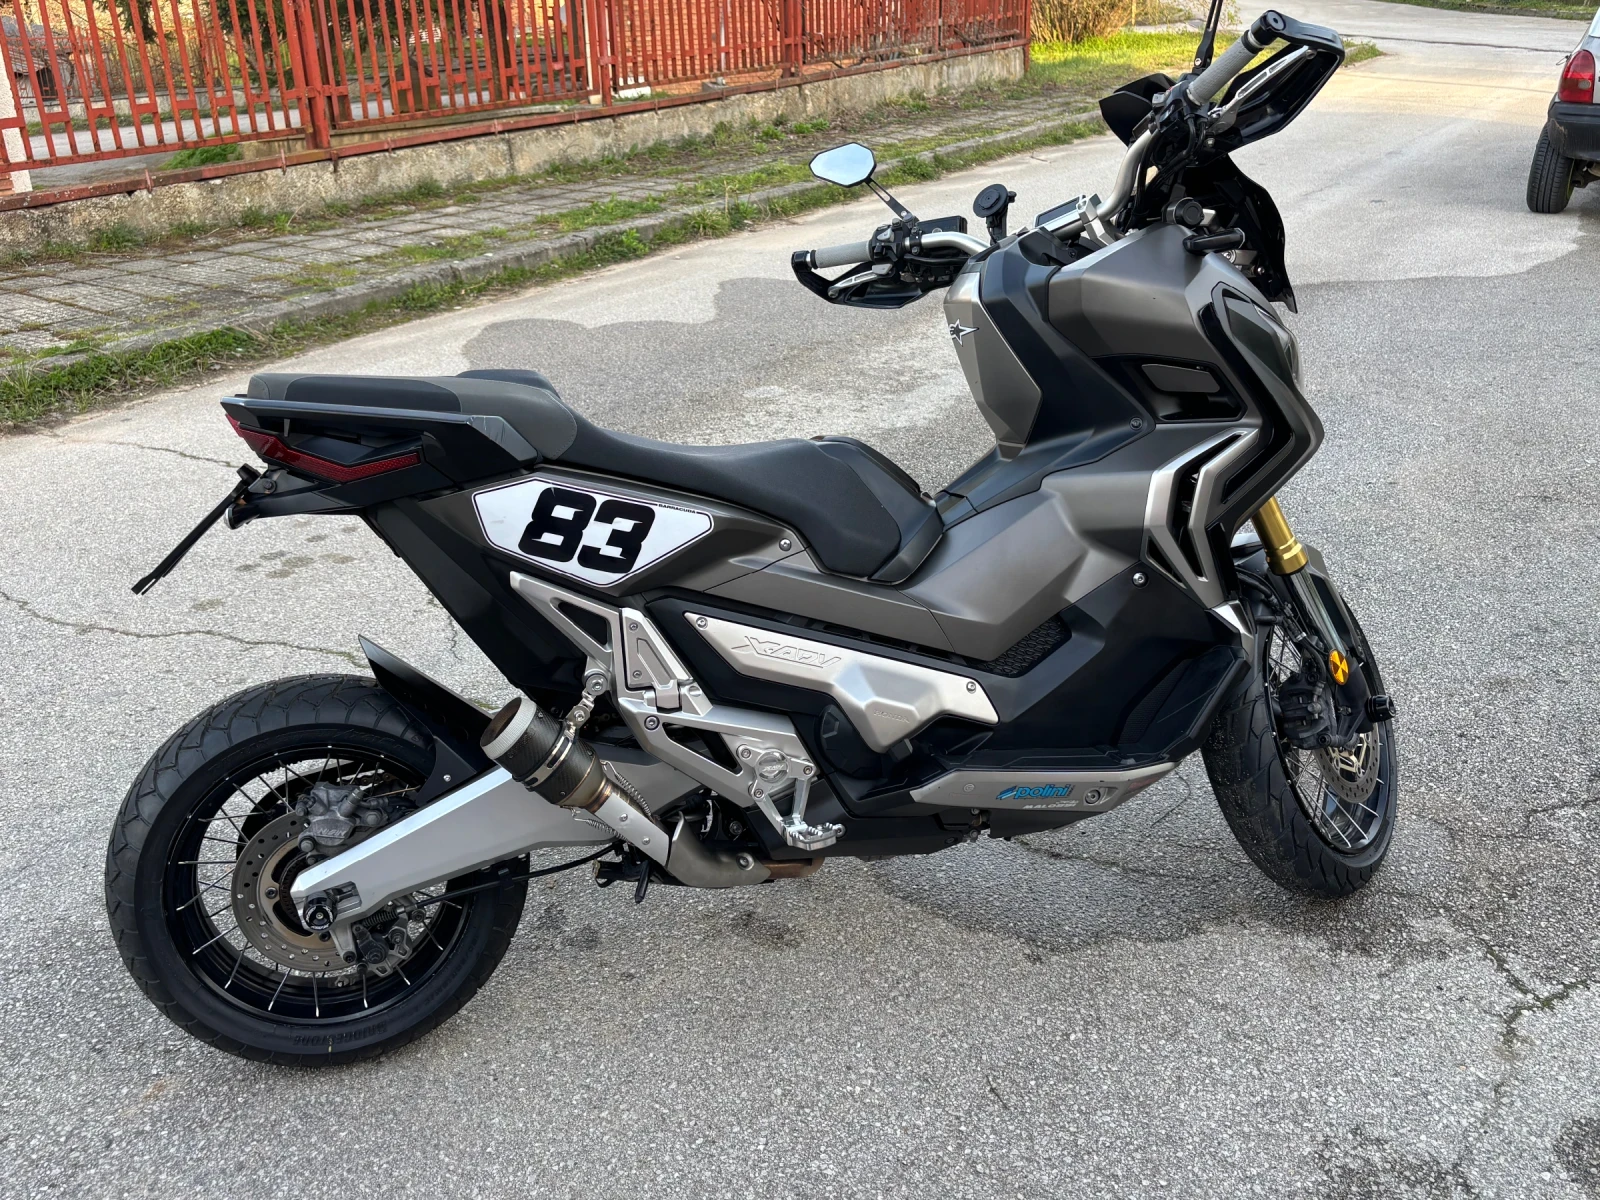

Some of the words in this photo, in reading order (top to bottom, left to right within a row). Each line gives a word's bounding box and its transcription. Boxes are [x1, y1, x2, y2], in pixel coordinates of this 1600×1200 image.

[658, 503, 696, 514] BARRACUDA
[518, 486, 656, 574] 83
[1013, 783, 1071, 799] polini
[292, 1020, 388, 1047] BRIDGESTONE
